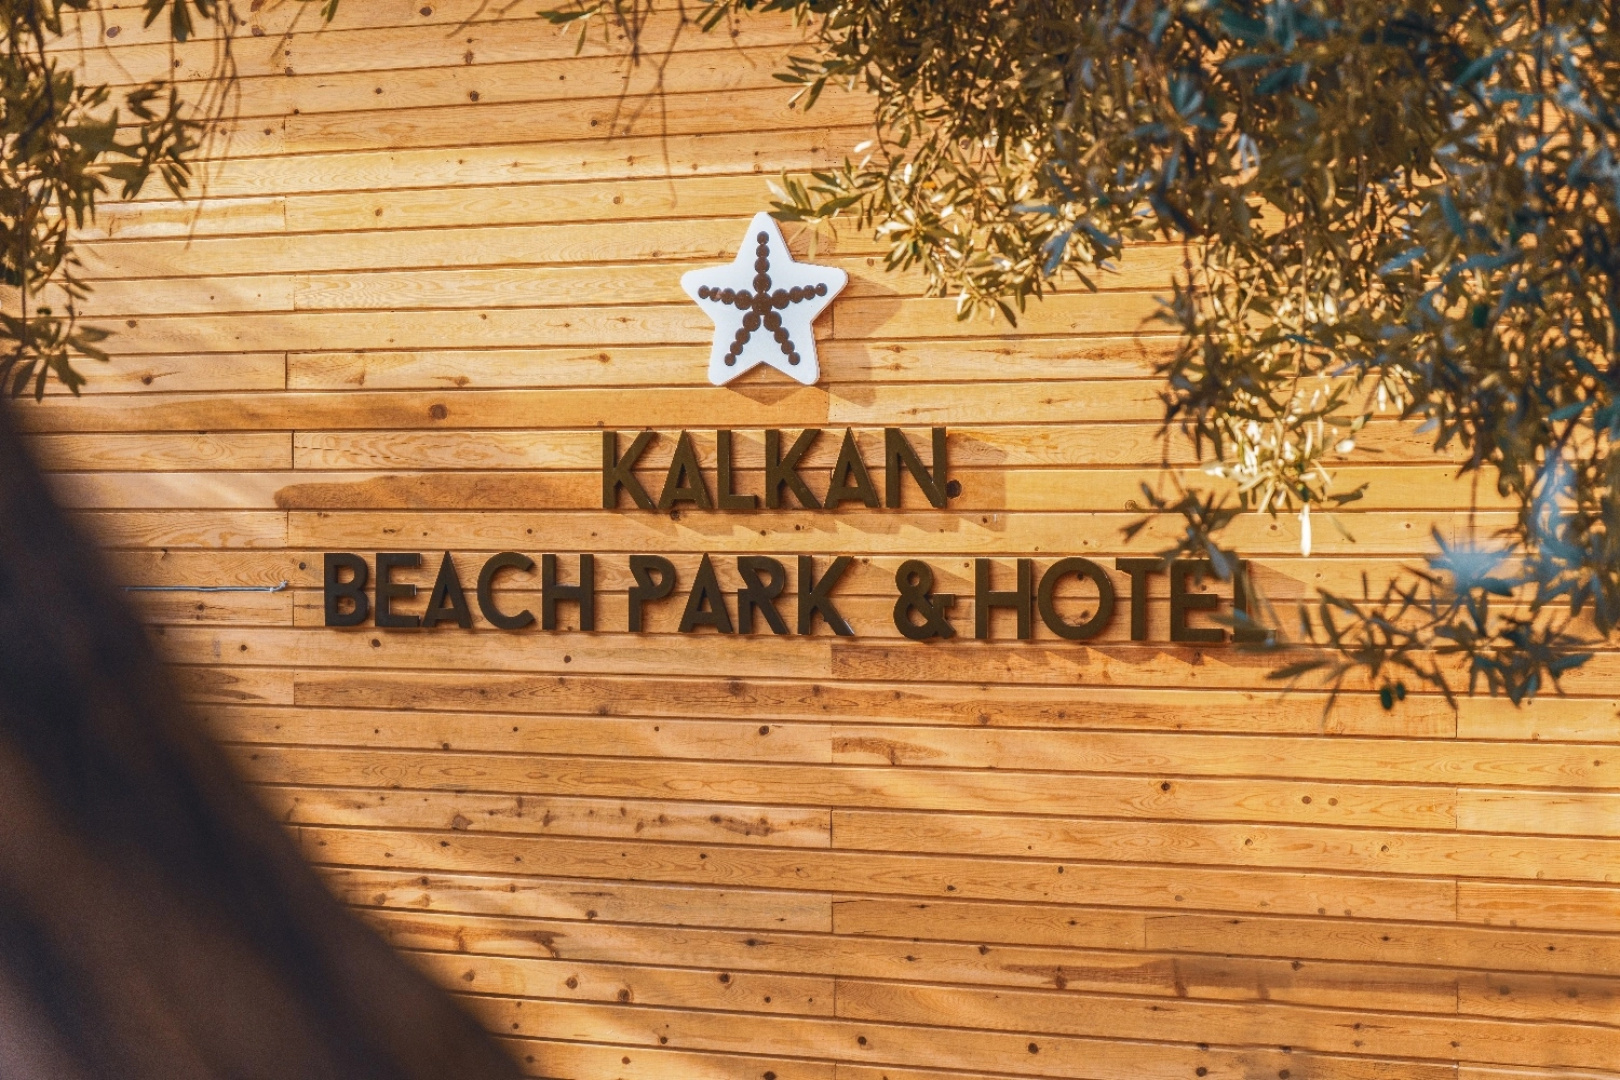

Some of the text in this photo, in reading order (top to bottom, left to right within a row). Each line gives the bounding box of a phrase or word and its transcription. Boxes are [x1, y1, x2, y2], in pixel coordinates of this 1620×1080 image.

[602, 426, 947, 509] KALKAN
[323, 550, 1277, 643] BEACH PARK & HOTEL
